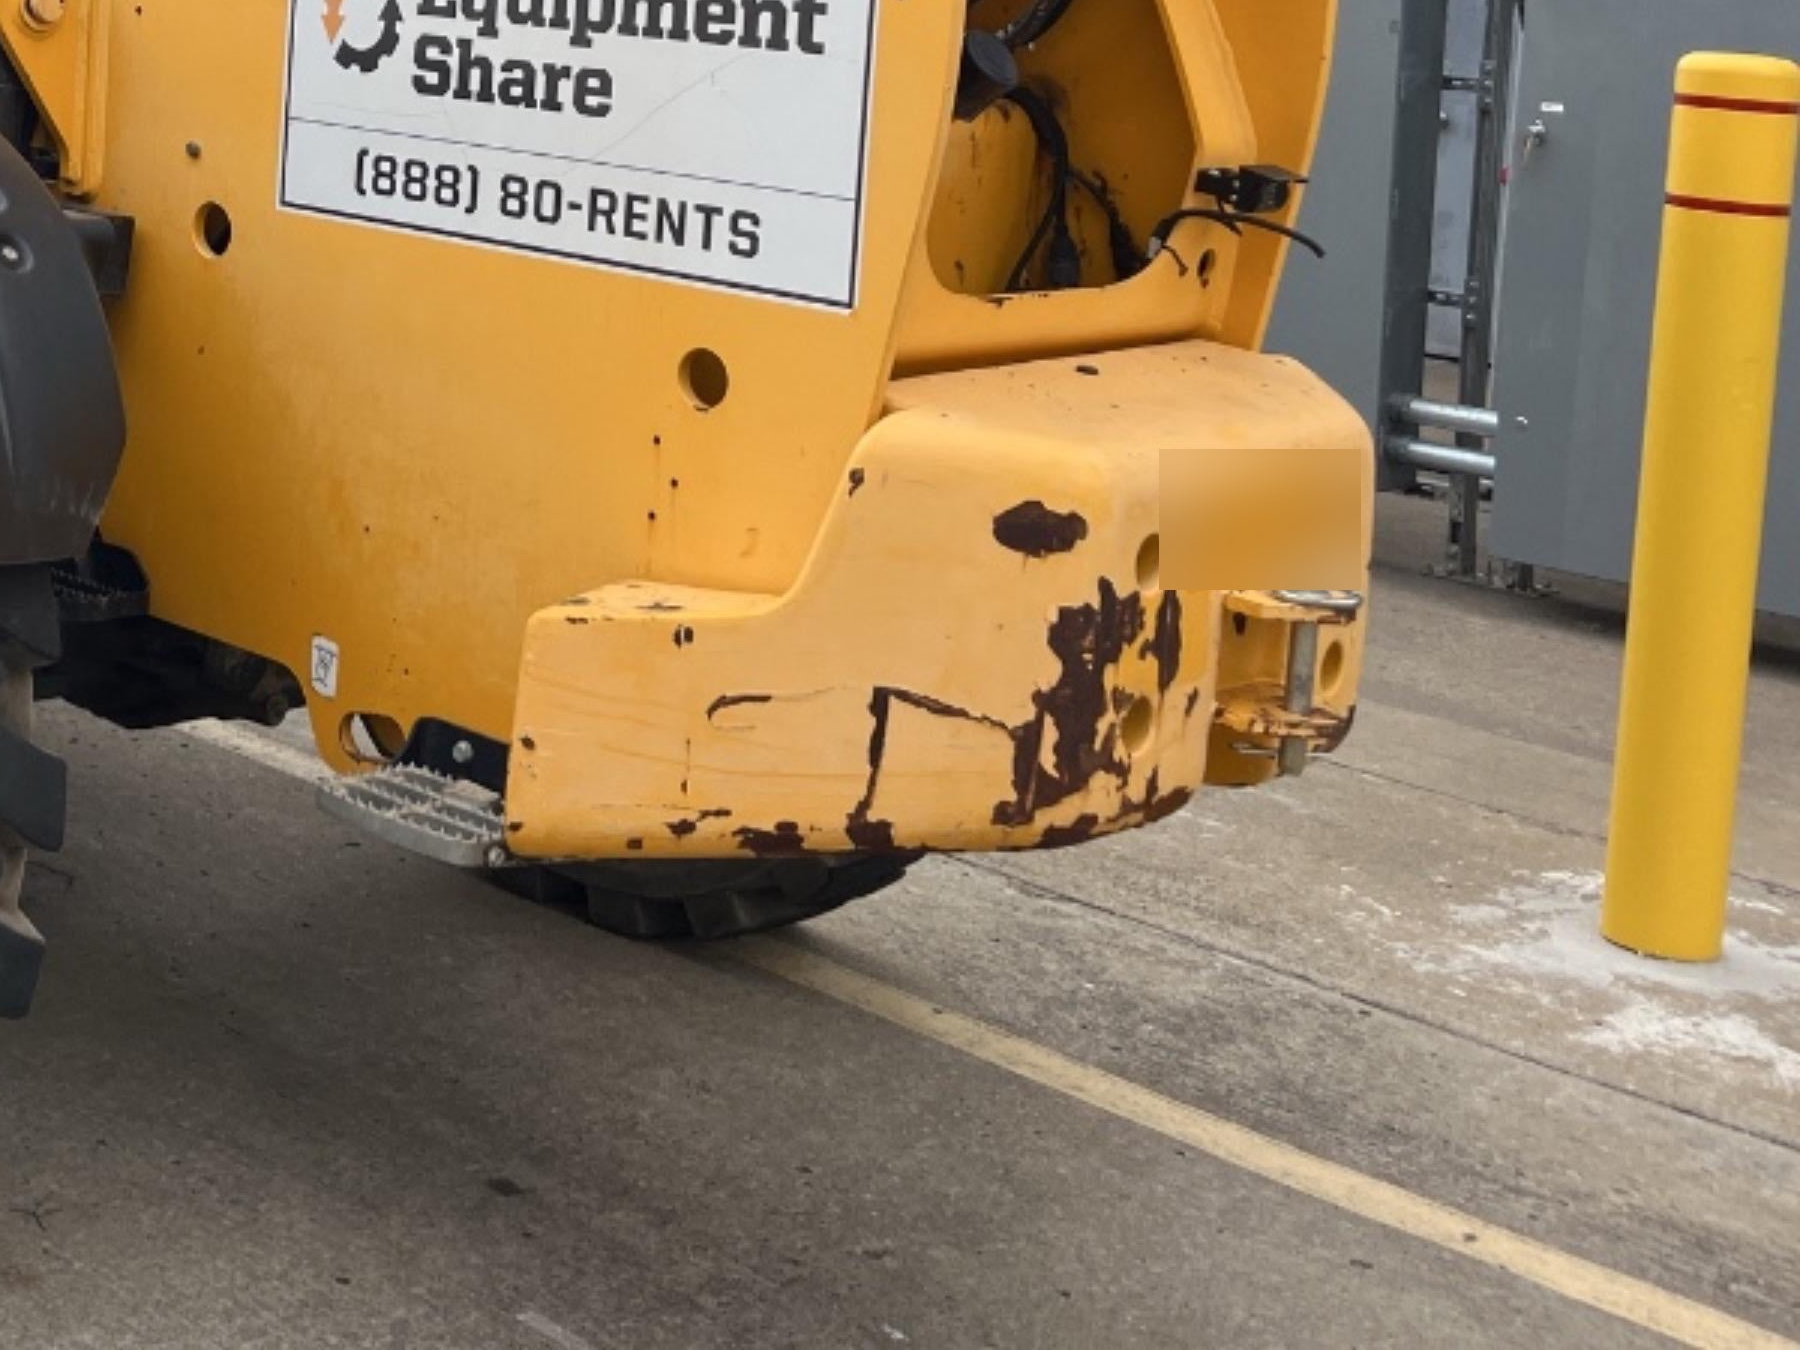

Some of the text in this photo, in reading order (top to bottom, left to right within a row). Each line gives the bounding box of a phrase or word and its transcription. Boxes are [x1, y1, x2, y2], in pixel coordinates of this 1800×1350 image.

[411, 35, 613, 118] Share
[354, 148, 762, 259] (888) 80-RENTS
